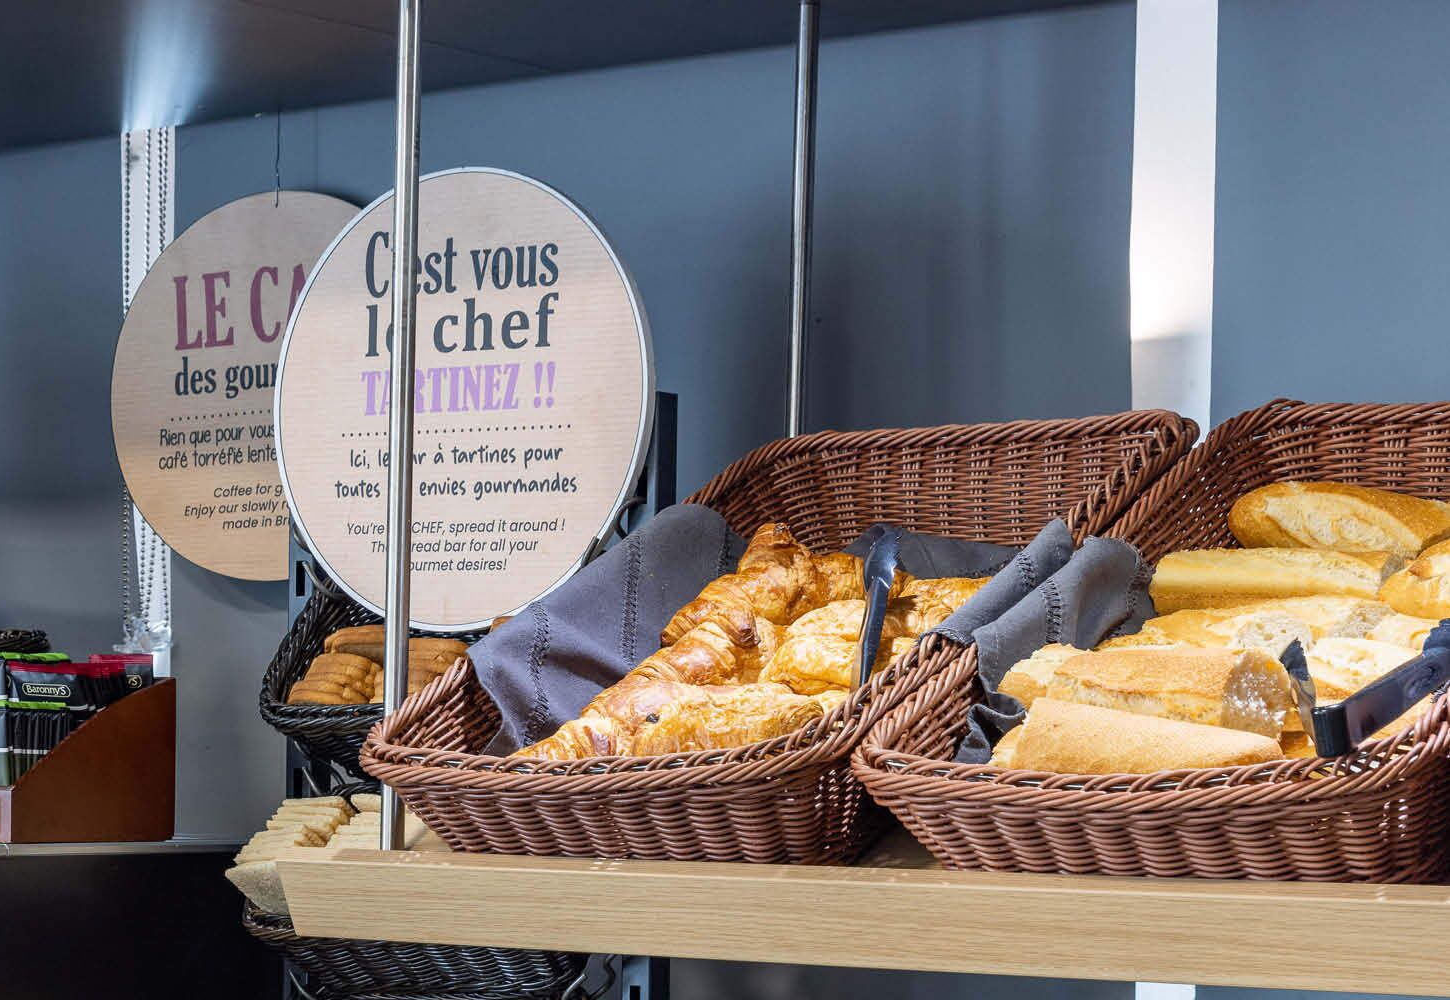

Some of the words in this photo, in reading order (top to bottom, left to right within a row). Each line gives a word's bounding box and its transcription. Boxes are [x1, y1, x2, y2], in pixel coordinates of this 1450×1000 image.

[470, 242, 559, 290] vous
[173, 270, 235, 351] LE
[433, 292, 559, 353] chef
[174, 356, 217, 396] des
[533, 361, 556, 409] !!
[159, 428, 186, 446] Rien
[189, 430, 211, 449] que
[215, 426, 244, 446] pour
[249, 424, 275, 439] vous
[158, 453, 188, 470] café
[194, 449, 243, 467] torréfié
[350, 449, 370, 469] Ici,
[433, 443, 445, 465] à
[452, 446, 516, 465] tartines
[524, 446, 563, 469] pour
[213, 485, 253, 498] Coffee
[255, 483, 271, 495] for
[334, 480, 381, 498] toutes
[419, 476, 467, 496] envies
[473, 472, 578, 500] gourmandes
[184, 503, 216, 519] Enjoy
[218, 504, 238, 513] our
[241, 500, 279, 517] slowly
[222, 517, 259, 530] made
[261, 516, 272, 527] in
[347, 522, 385, 535] You're
[412, 521, 446, 535] CHEF,
[449, 520, 494, 536] spread
[497, 519, 507, 532] it
[509, 519, 557, 532] around
[561, 518, 566, 531] !
[412, 540, 441, 553] read
[443, 540, 466, 553] bar
[469, 540, 486, 552] for
[489, 539, 506, 552] all
[508, 540, 538, 557] your
[410, 560, 453, 572] ourmet
[457, 558, 507, 571] desires!
